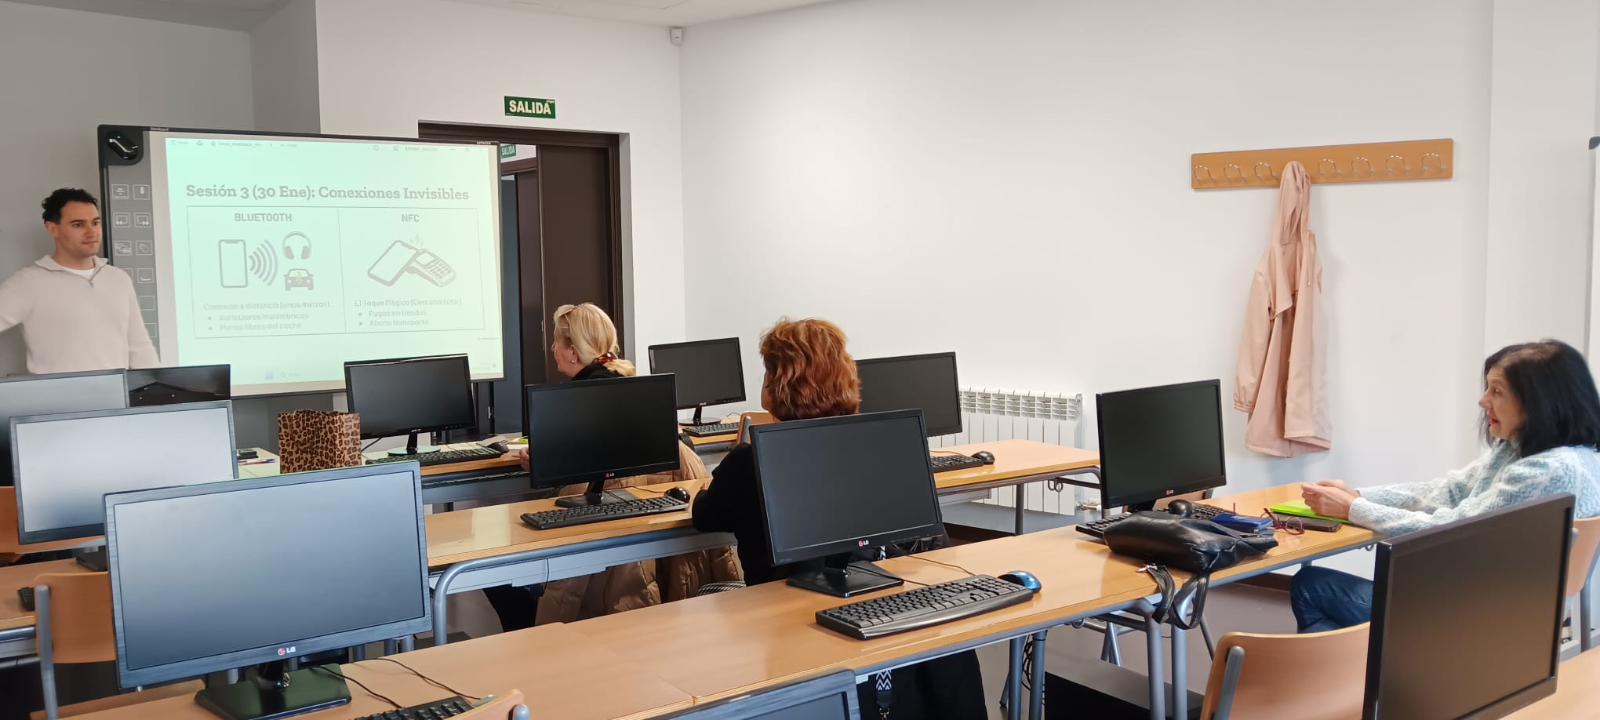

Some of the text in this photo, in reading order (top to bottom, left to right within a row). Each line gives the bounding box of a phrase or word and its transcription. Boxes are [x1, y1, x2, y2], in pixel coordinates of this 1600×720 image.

[509, 100, 552, 115] SALIDA
[186, 184, 469, 200] Sesión 3 (30 Ene): Conexiones Invisibles
[234, 213, 292, 222] BLUETOOTH
[401, 214, 420, 223] NFC
[363, 299, 385, 308] Toque
